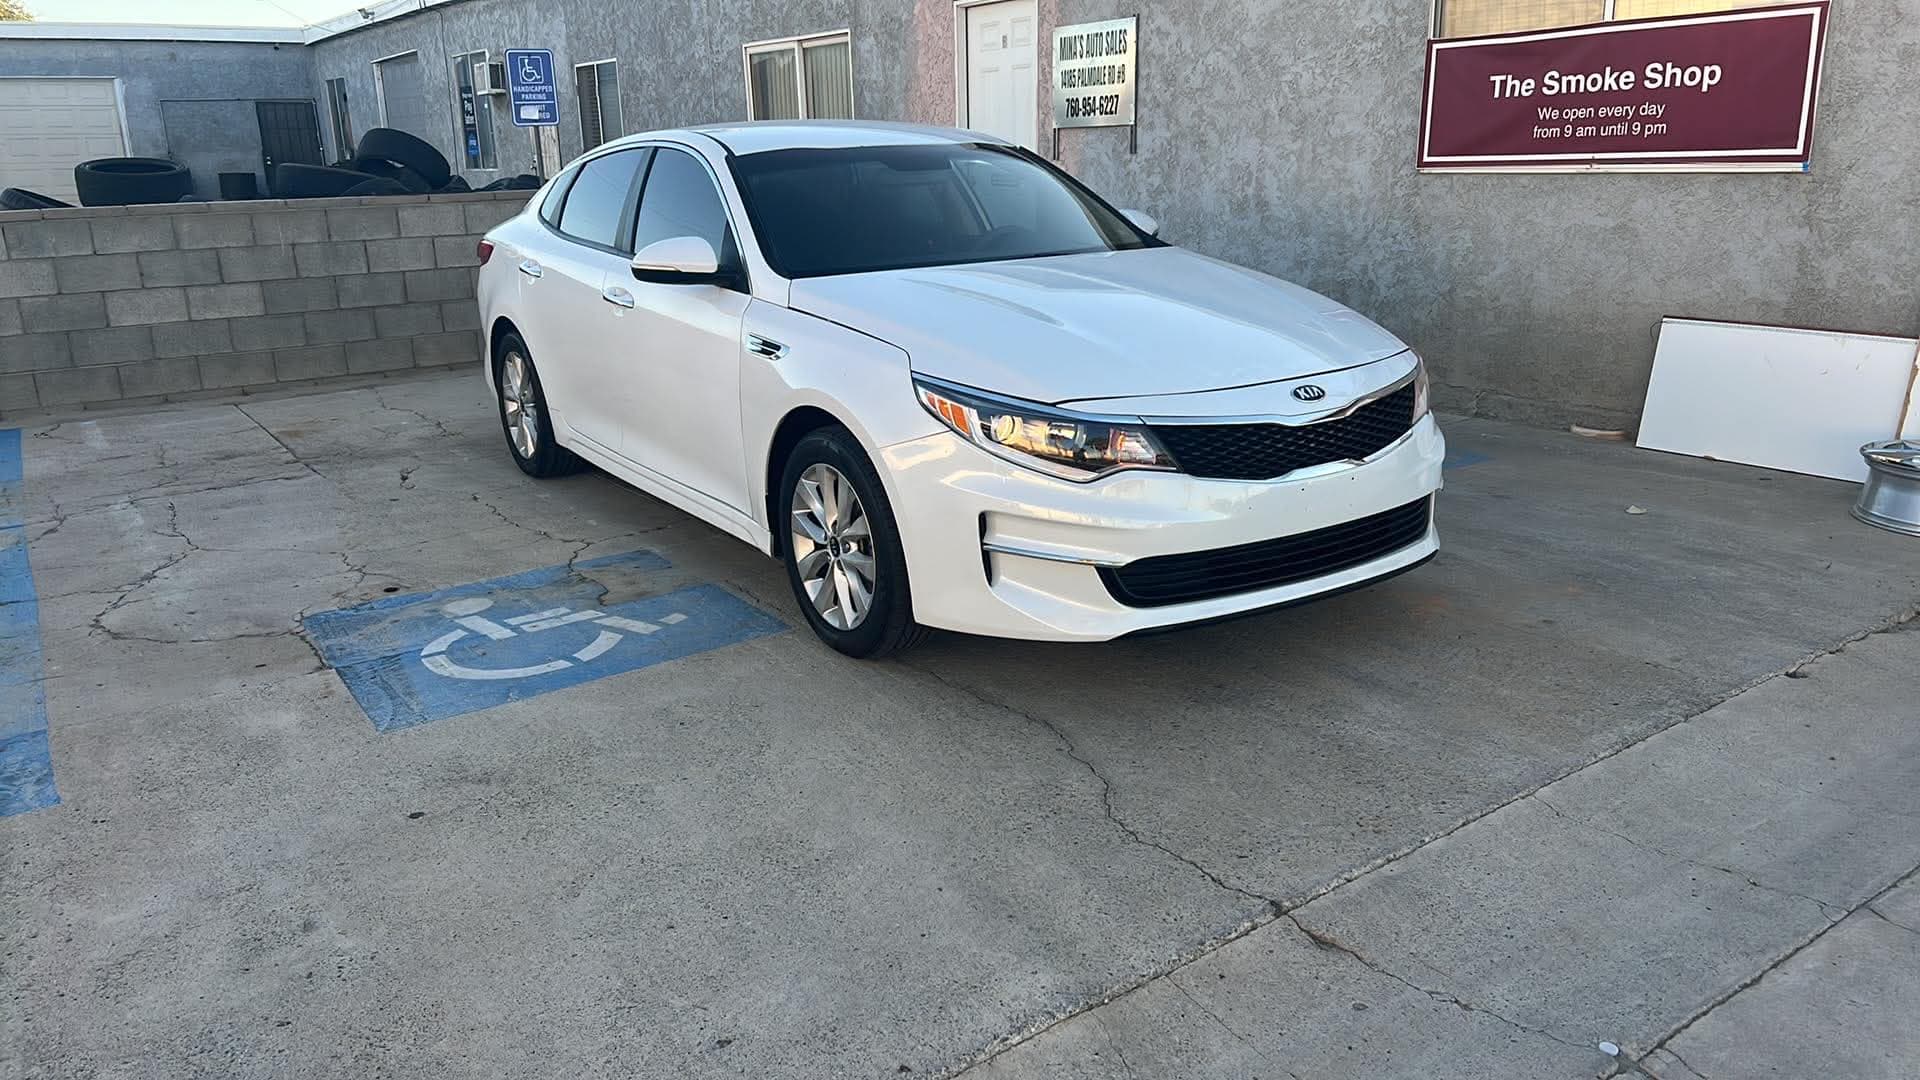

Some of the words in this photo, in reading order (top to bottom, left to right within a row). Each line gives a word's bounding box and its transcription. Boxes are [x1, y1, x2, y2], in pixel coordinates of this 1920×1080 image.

[1060, 34, 1084, 61] MINA'S
[1086, 31, 1103, 58] AUTO
[1105, 28, 1127, 56] SALES
[1077, 65, 1106, 88] PALMDALE
[1108, 65, 1115, 84] RD
[1489, 74, 1536, 98] The
[1541, 66, 1635, 96] Smoke
[1644, 61, 1722, 92] Shop
[513, 85, 553, 93] HANDICAPPED
[1065, 94, 1119, 118] 760-954-6227
[1537, 107, 1559, 120] We
[1562, 107, 1594, 122] open
[1598, 105, 1635, 121] every
[1639, 102, 1665, 119] day
[1533, 126, 1560, 139] from
[1563, 125, 1573, 138] 9
[1575, 126, 1596, 138] am
[1600, 122, 1628, 136] until
[1631, 122, 1641, 135] 9
[1644, 122, 1667, 138] pm
[1295, 386, 1324, 400] KIA
